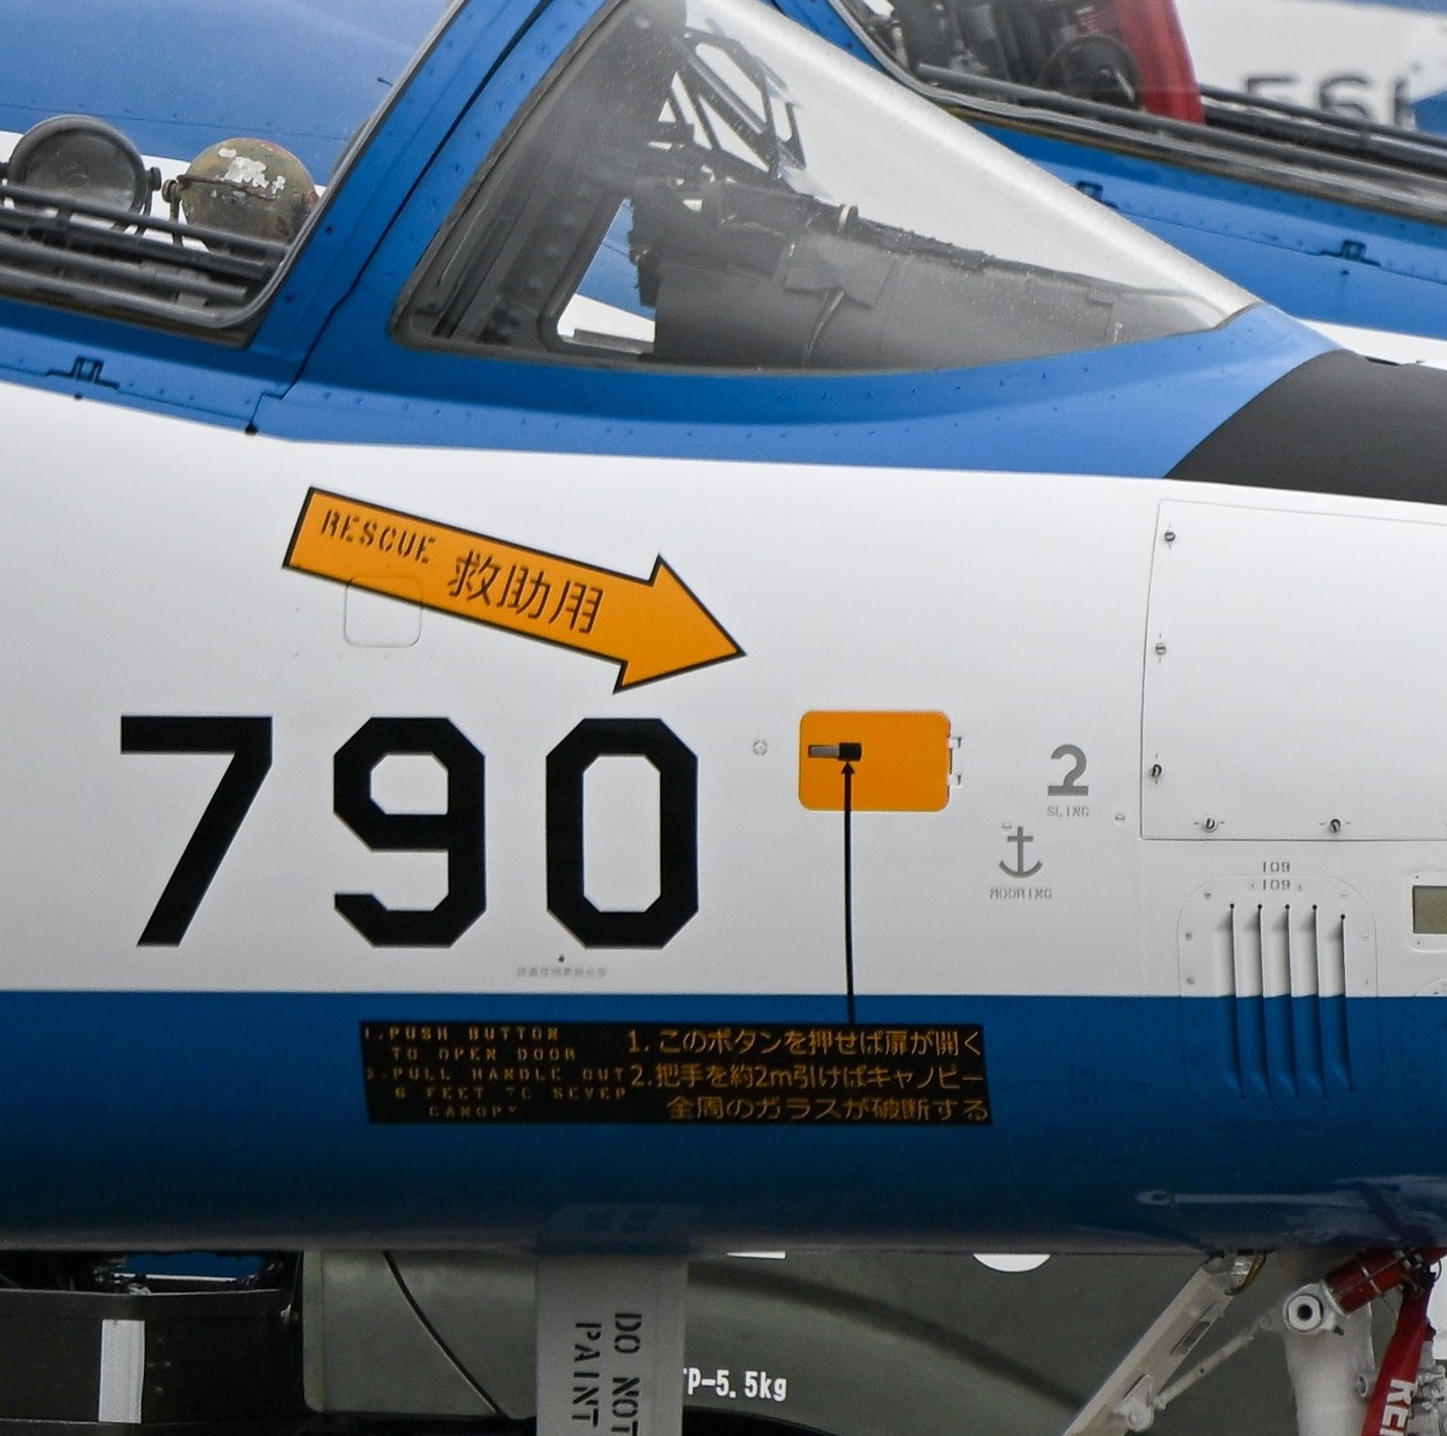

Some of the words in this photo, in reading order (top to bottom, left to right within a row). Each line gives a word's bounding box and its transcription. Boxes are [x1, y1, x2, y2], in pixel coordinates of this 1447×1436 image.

[321, 508, 437, 564] RESCUE
[447, 549, 606, 635] 救助用
[1047, 805, 1090, 818] SLING
[120, 714, 699, 949] 790
[1261, 861, 1291, 873] 109
[1261, 879, 1291, 891] 109
[989, 888, 1053, 901] MOORING
[468, 1027, 560, 1042] BUTTON
[391, 1047, 419, 1061] TO
[438, 1047, 498, 1062] OPEN
[582, 1067, 624, 1081] OUT
[614, 1312, 643, 1354] DO
[571, 1322, 602, 1428] PAINT
